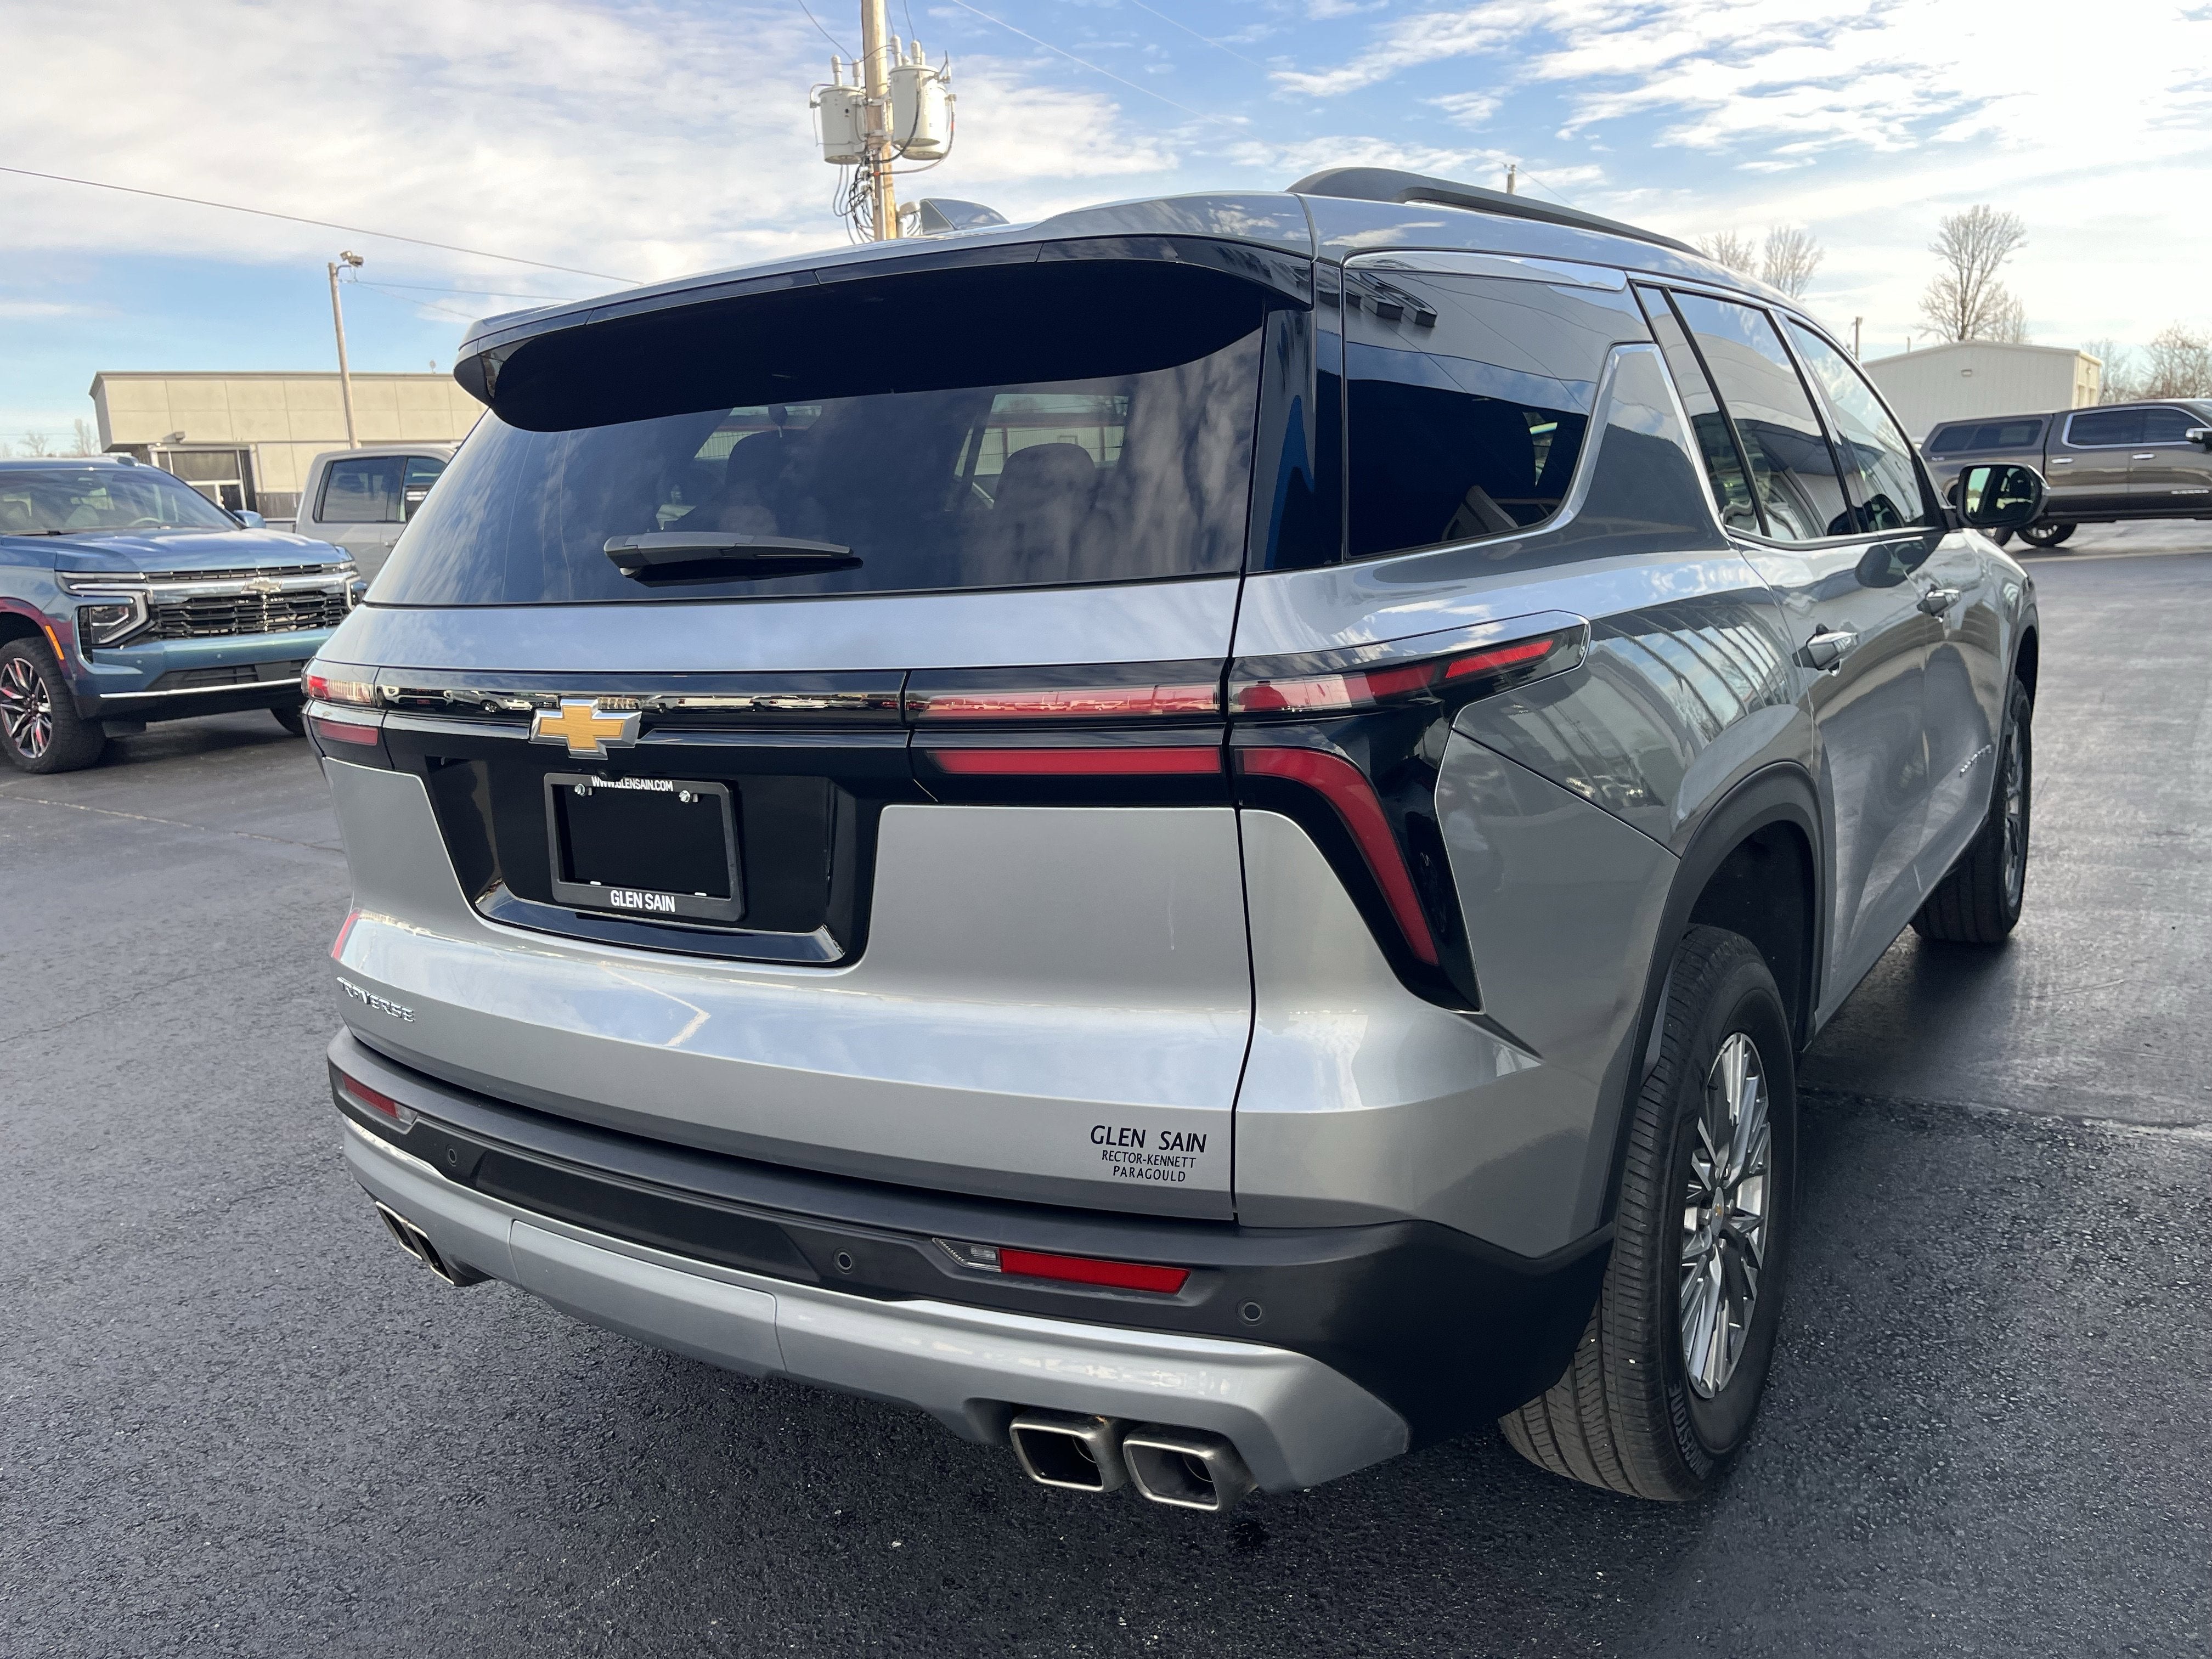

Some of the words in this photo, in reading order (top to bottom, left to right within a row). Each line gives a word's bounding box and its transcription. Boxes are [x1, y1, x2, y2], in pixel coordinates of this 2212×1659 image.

[591, 776, 673, 792] WWW.GLENSAIN.COM
[611, 890, 643, 909] GLEN
[645, 893, 675, 912] SAIN
[1091, 1125, 1146, 1148] GLEN
[1158, 1131, 1207, 1153] SAIN
[1102, 1150, 1197, 1168] RECTOR-KENNETT
[1113, 1165, 1186, 1182] PARAGOULD
